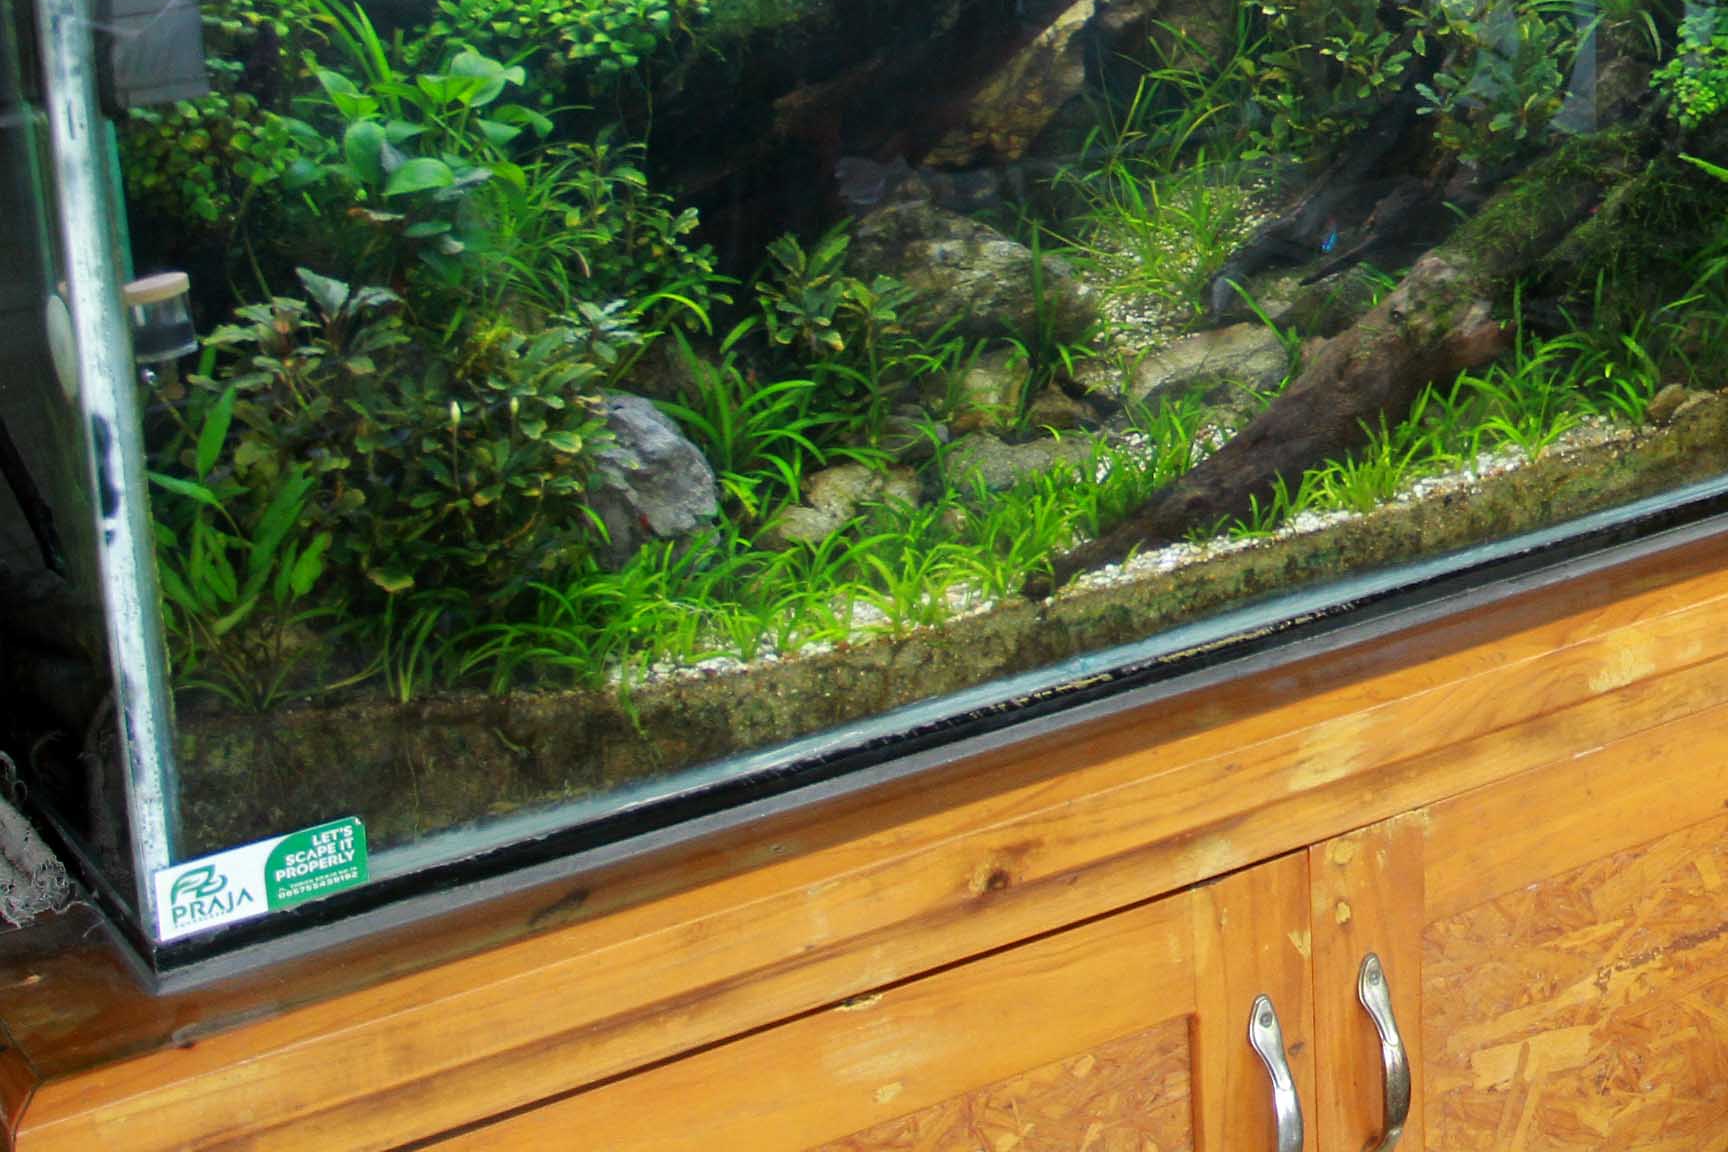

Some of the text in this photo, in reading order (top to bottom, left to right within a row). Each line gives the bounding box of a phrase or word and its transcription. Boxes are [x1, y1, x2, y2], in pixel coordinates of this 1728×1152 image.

[312, 825, 353, 846] LET'S
[275, 849, 356, 883] PROPERLY
[285, 837, 354, 866] SCAPE IT
[172, 888, 254, 927] PRAJA
